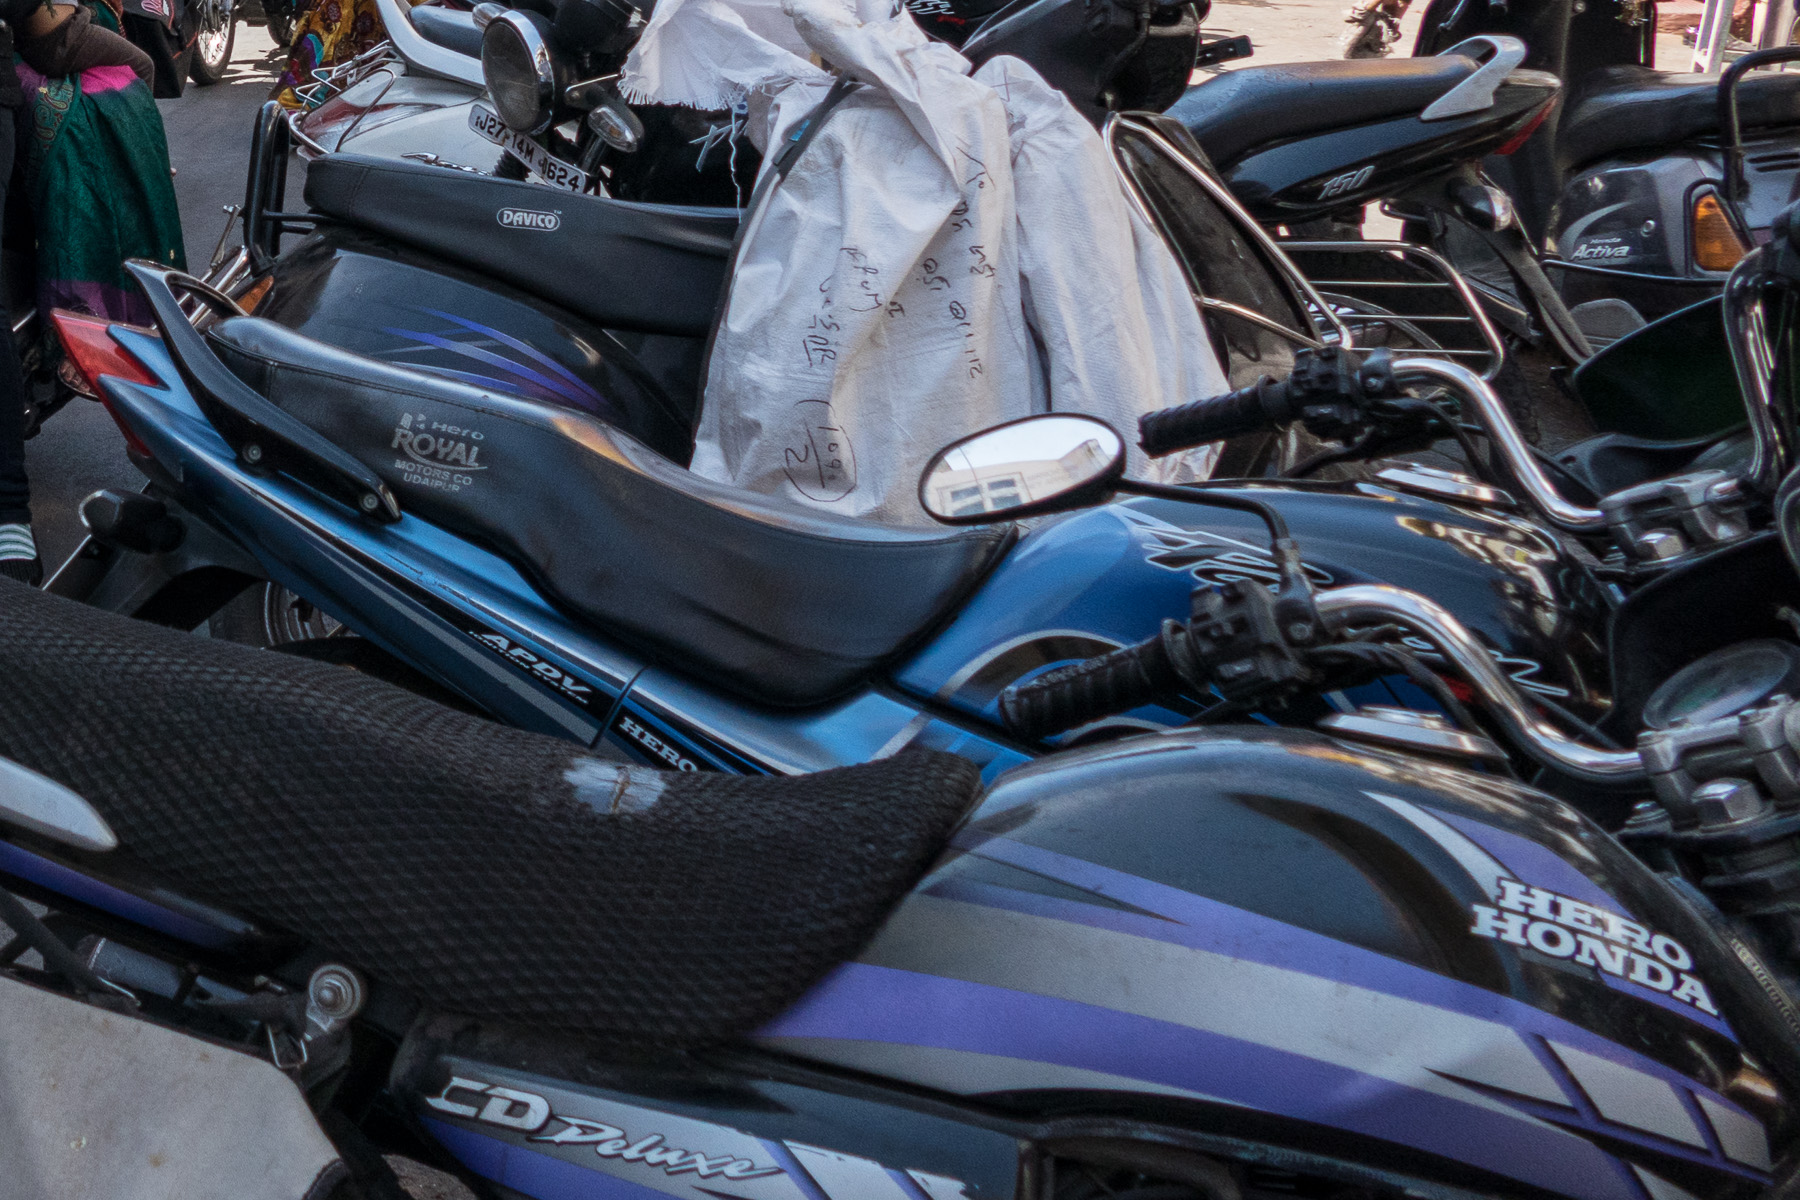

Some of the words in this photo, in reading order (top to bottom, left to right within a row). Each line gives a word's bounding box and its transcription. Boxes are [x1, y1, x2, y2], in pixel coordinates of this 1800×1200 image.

[1317, 165, 1375, 200] 150
[501, 209, 558, 230] DAVICO
[1570, 243, 1631, 261] Activa
[391, 427, 483, 468] ROYAL
[431, 421, 485, 441] Hero
[394, 458, 451, 480] MOTORS
[453, 473, 473, 486] CO
[402, 471, 460, 492] UDAIPUR
[477, 631, 597, 701] APDV
[617, 715, 699, 773] HERO
[1497, 876, 1694, 971] HERO
[1470, 903, 1719, 1015] HONDA
[424, 1075, 555, 1133] CD
[528, 1113, 787, 1179] Deluxe
